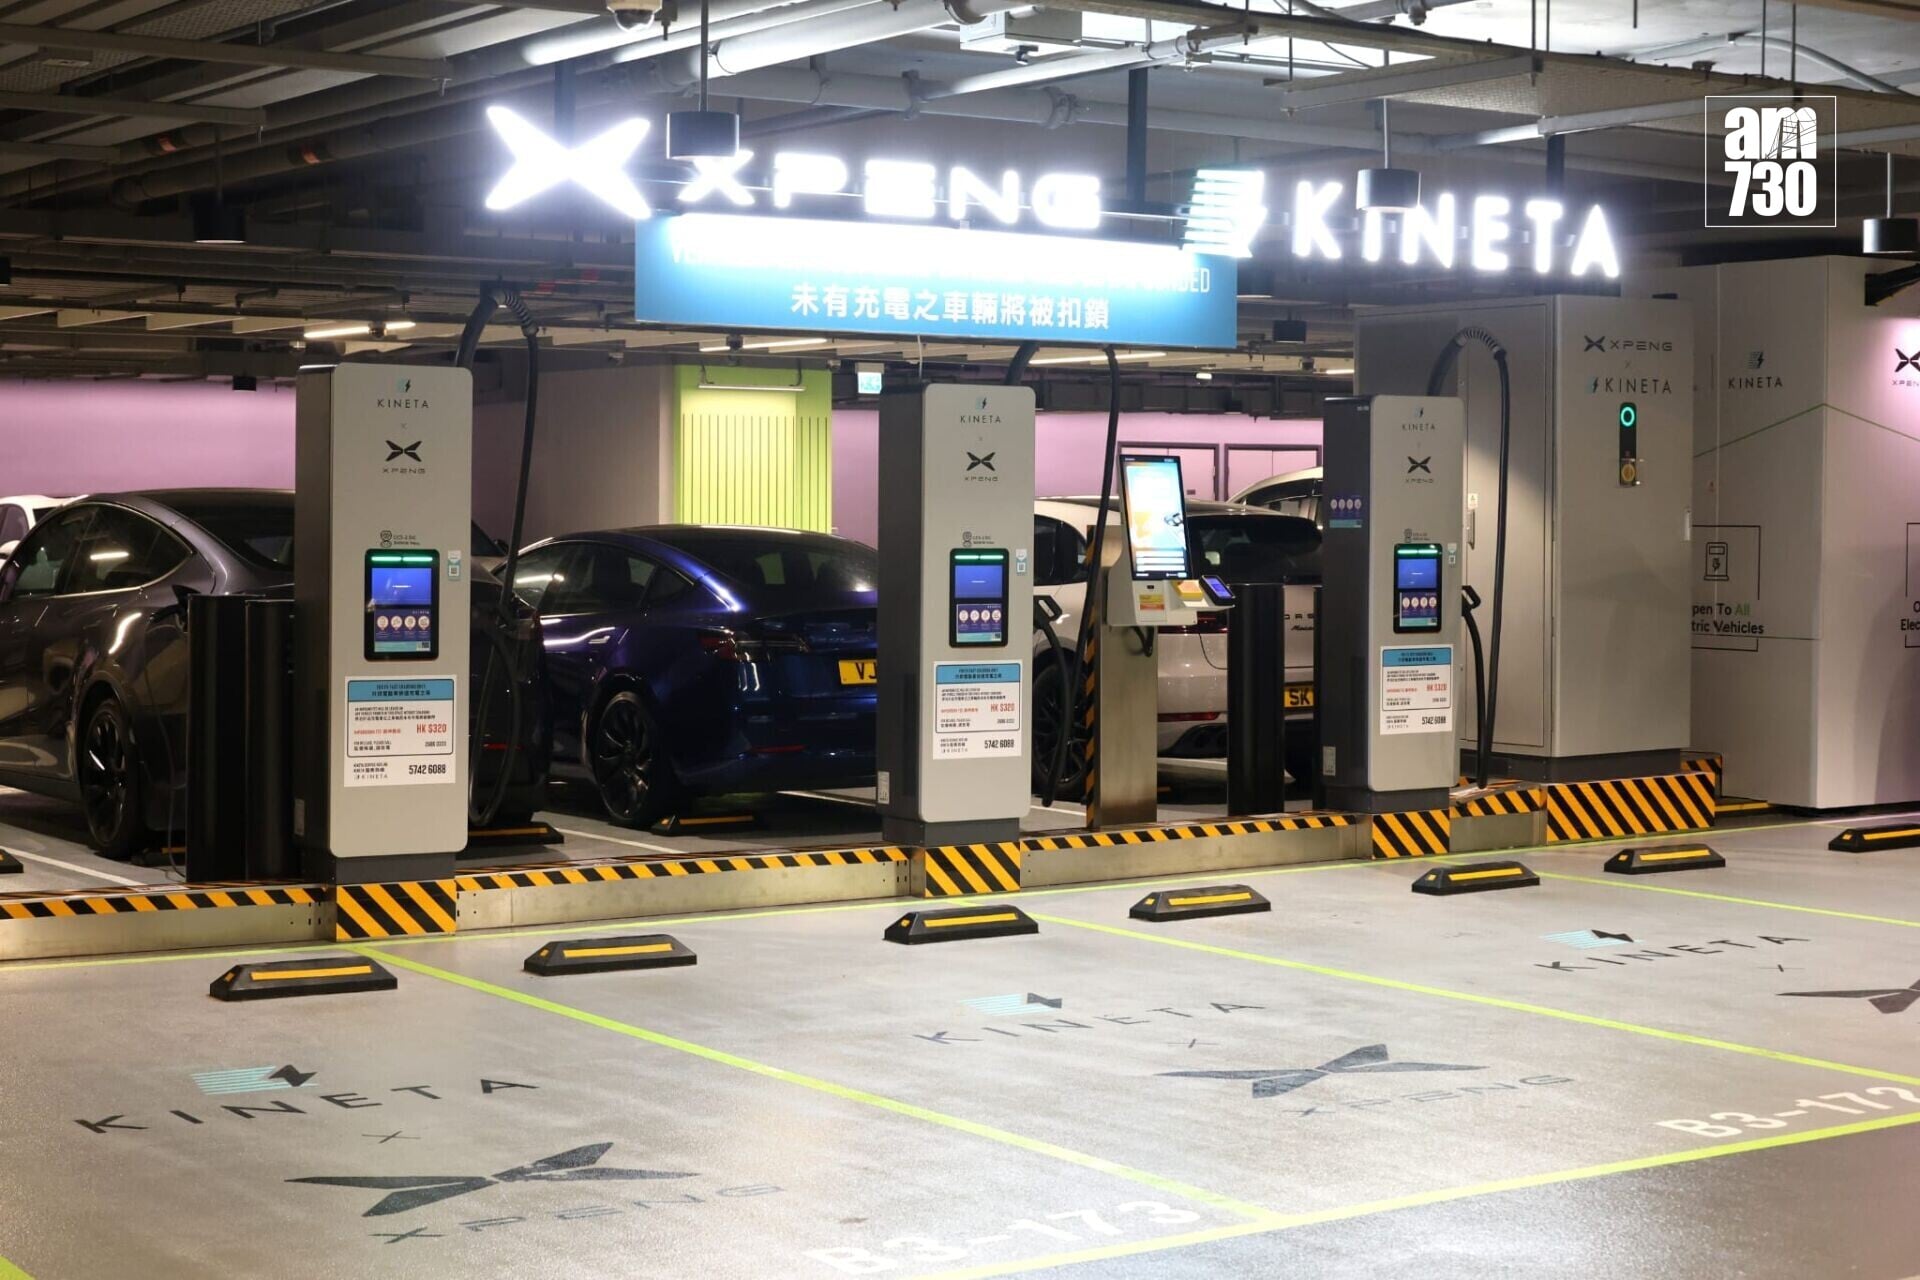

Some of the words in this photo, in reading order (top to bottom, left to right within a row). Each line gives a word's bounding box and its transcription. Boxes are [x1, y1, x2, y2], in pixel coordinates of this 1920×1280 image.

[677, 149, 1101, 229] XPENG
[1292, 180, 1621, 278] KINETA
[790, 283, 1109, 330] 未有充電之車輛將被扣鎖
[1610, 340, 1673, 351] XPENG
[1605, 377, 1672, 394] KINETA
[1728, 376, 1783, 389] KINETA
[377, 399, 429, 409] KINETA
[960, 415, 1001, 424] KINETA
[1401, 423, 1436, 431] KINETA
[1716, 603, 1732, 615] To
[1735, 601, 1750, 616] All
[1713, 620, 1764, 634] Vehicles
[1289, 688, 1310, 705] SK
[417, 724, 425, 734] HK
[984, 740, 998, 749] 5742
[408, 765, 427, 775] 5742
[428, 764, 446, 774] 6088
[1533, 935, 1811, 972] KINETA
[912, 1001, 1266, 1045] KINETA
[1283, 1074, 1576, 1117] XPENG
[75, 1078, 540, 1134] KINETA
[368, 1185, 788, 1244] XPENG
[801, 1200, 1201, 1276] B3-173
